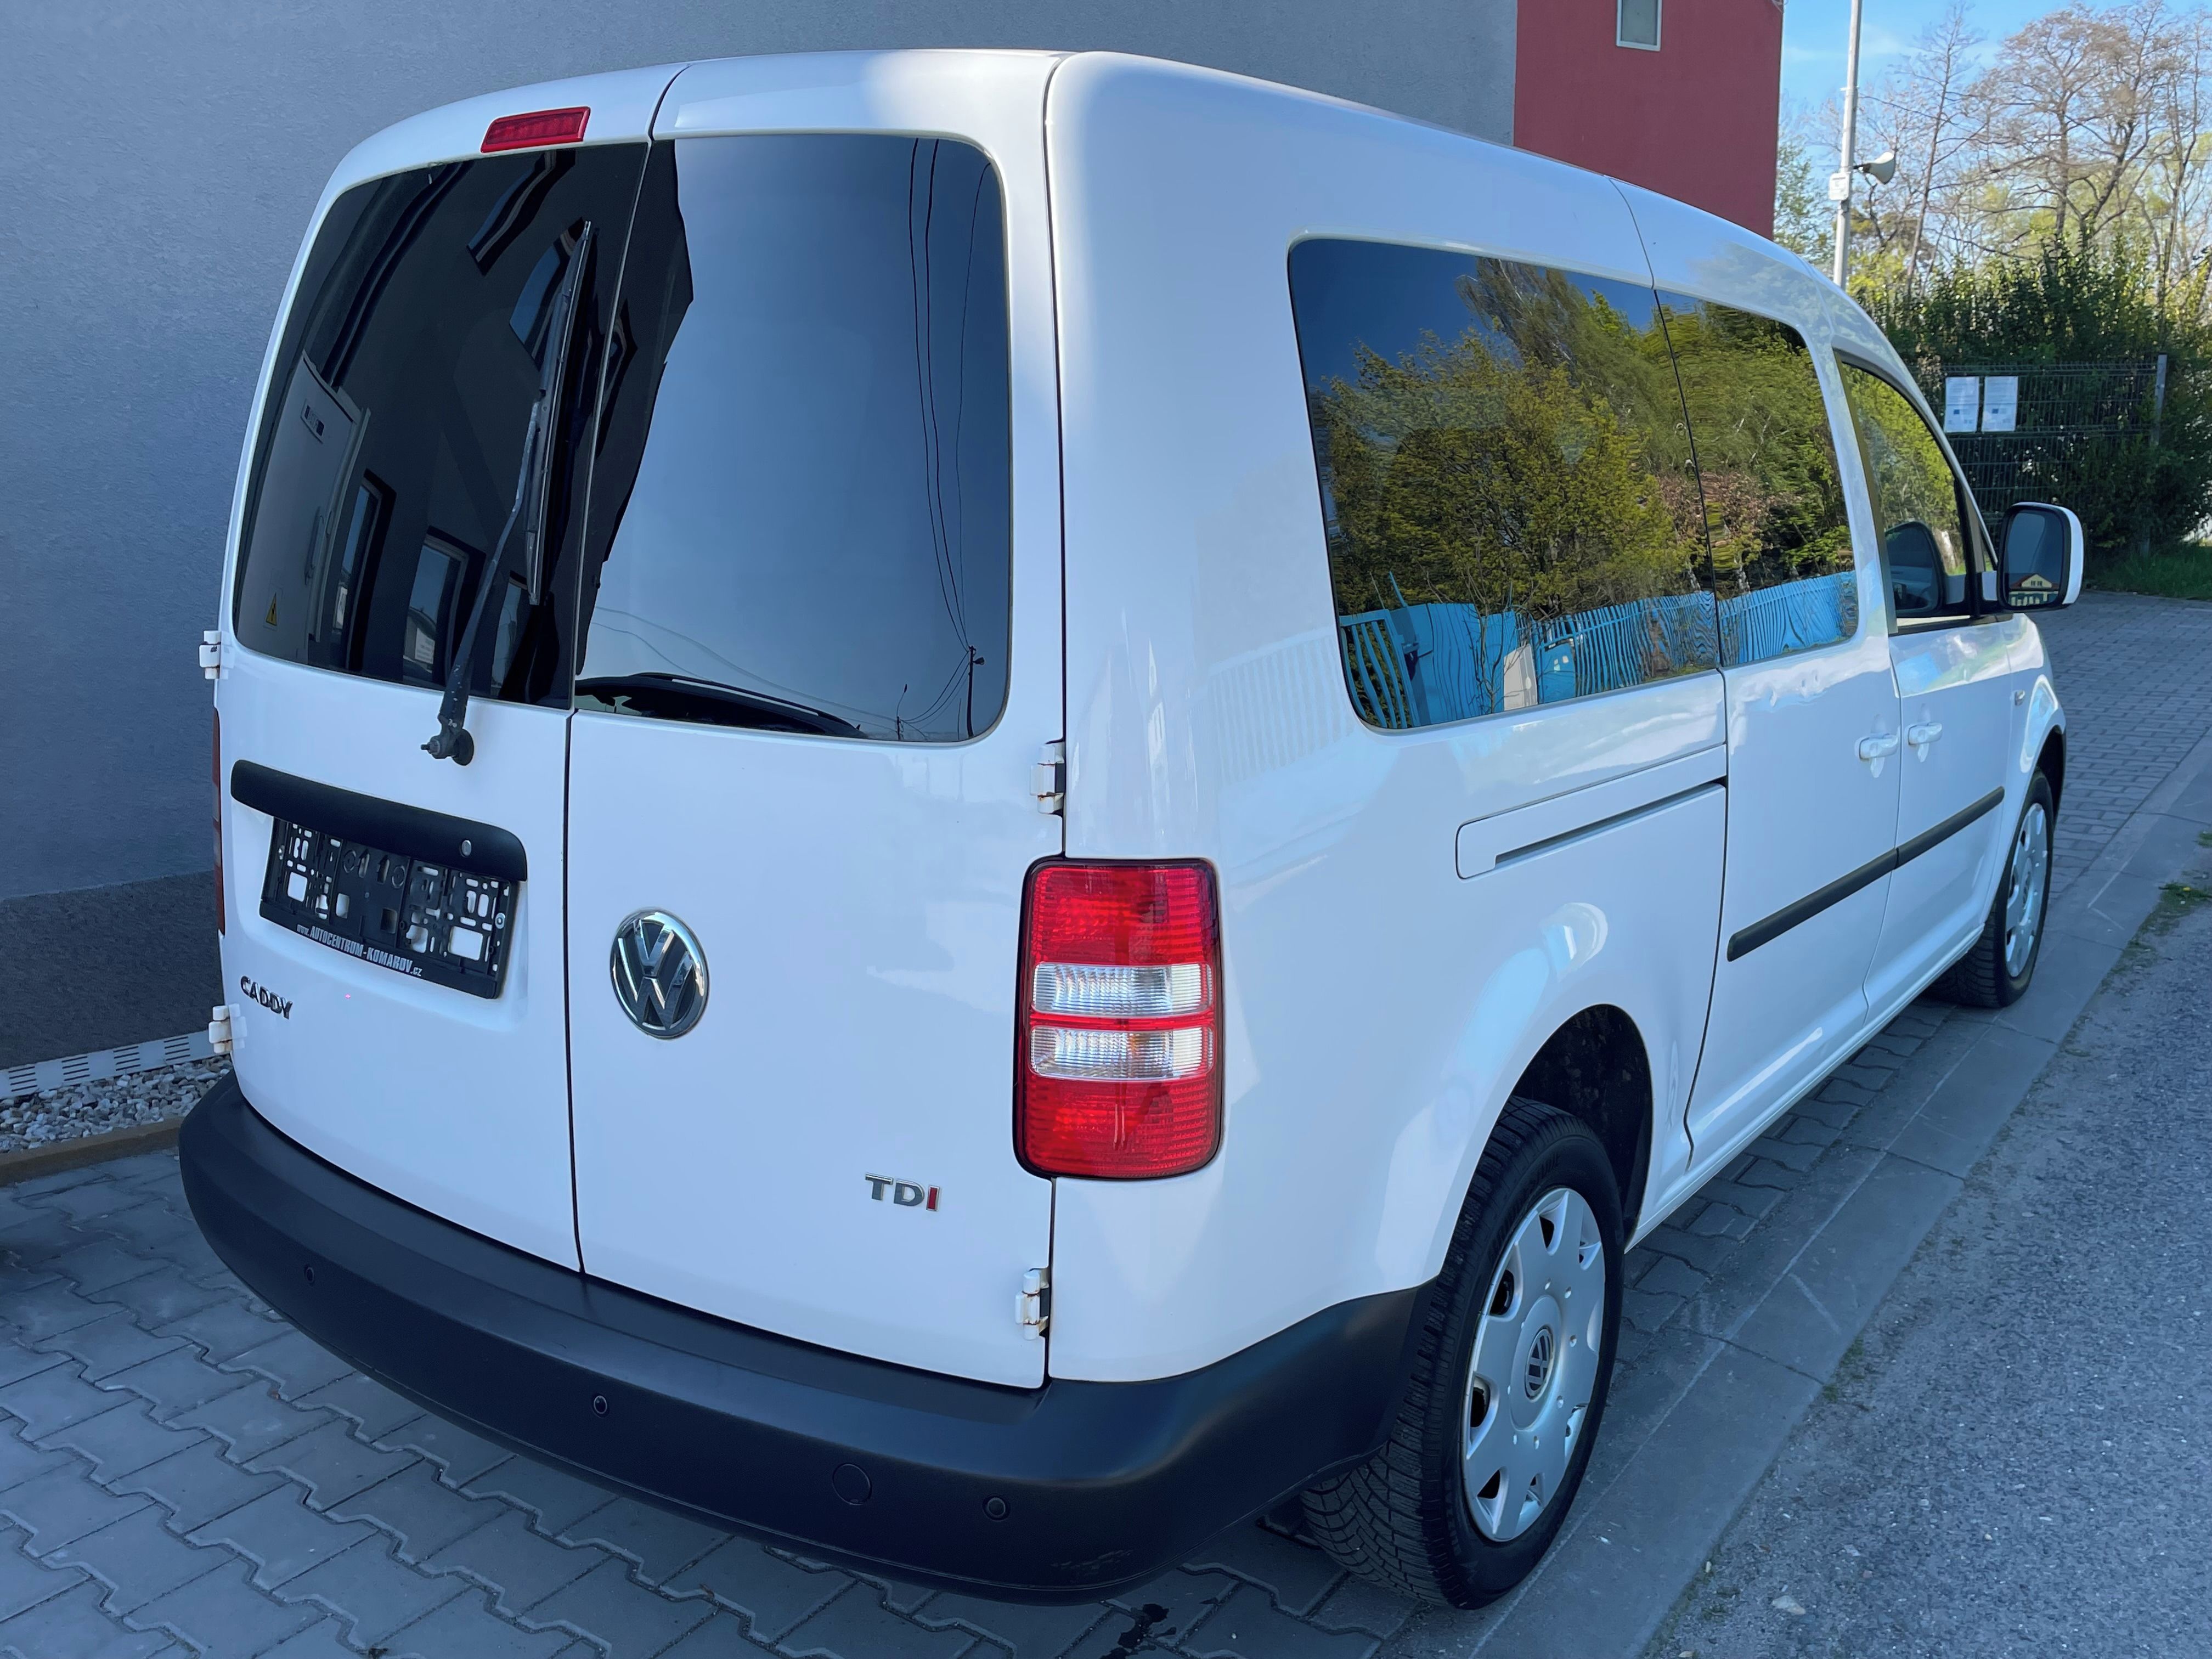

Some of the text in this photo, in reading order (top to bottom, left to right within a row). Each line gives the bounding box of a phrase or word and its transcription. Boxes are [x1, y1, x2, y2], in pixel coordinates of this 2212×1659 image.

[297, 924, 422, 977] www.AUTOCENTRUM-KOMAROV.cz
[611, 911, 706, 1036] VW
[240, 975, 293, 1020] CADDY
[865, 1172, 940, 1211] TDI
